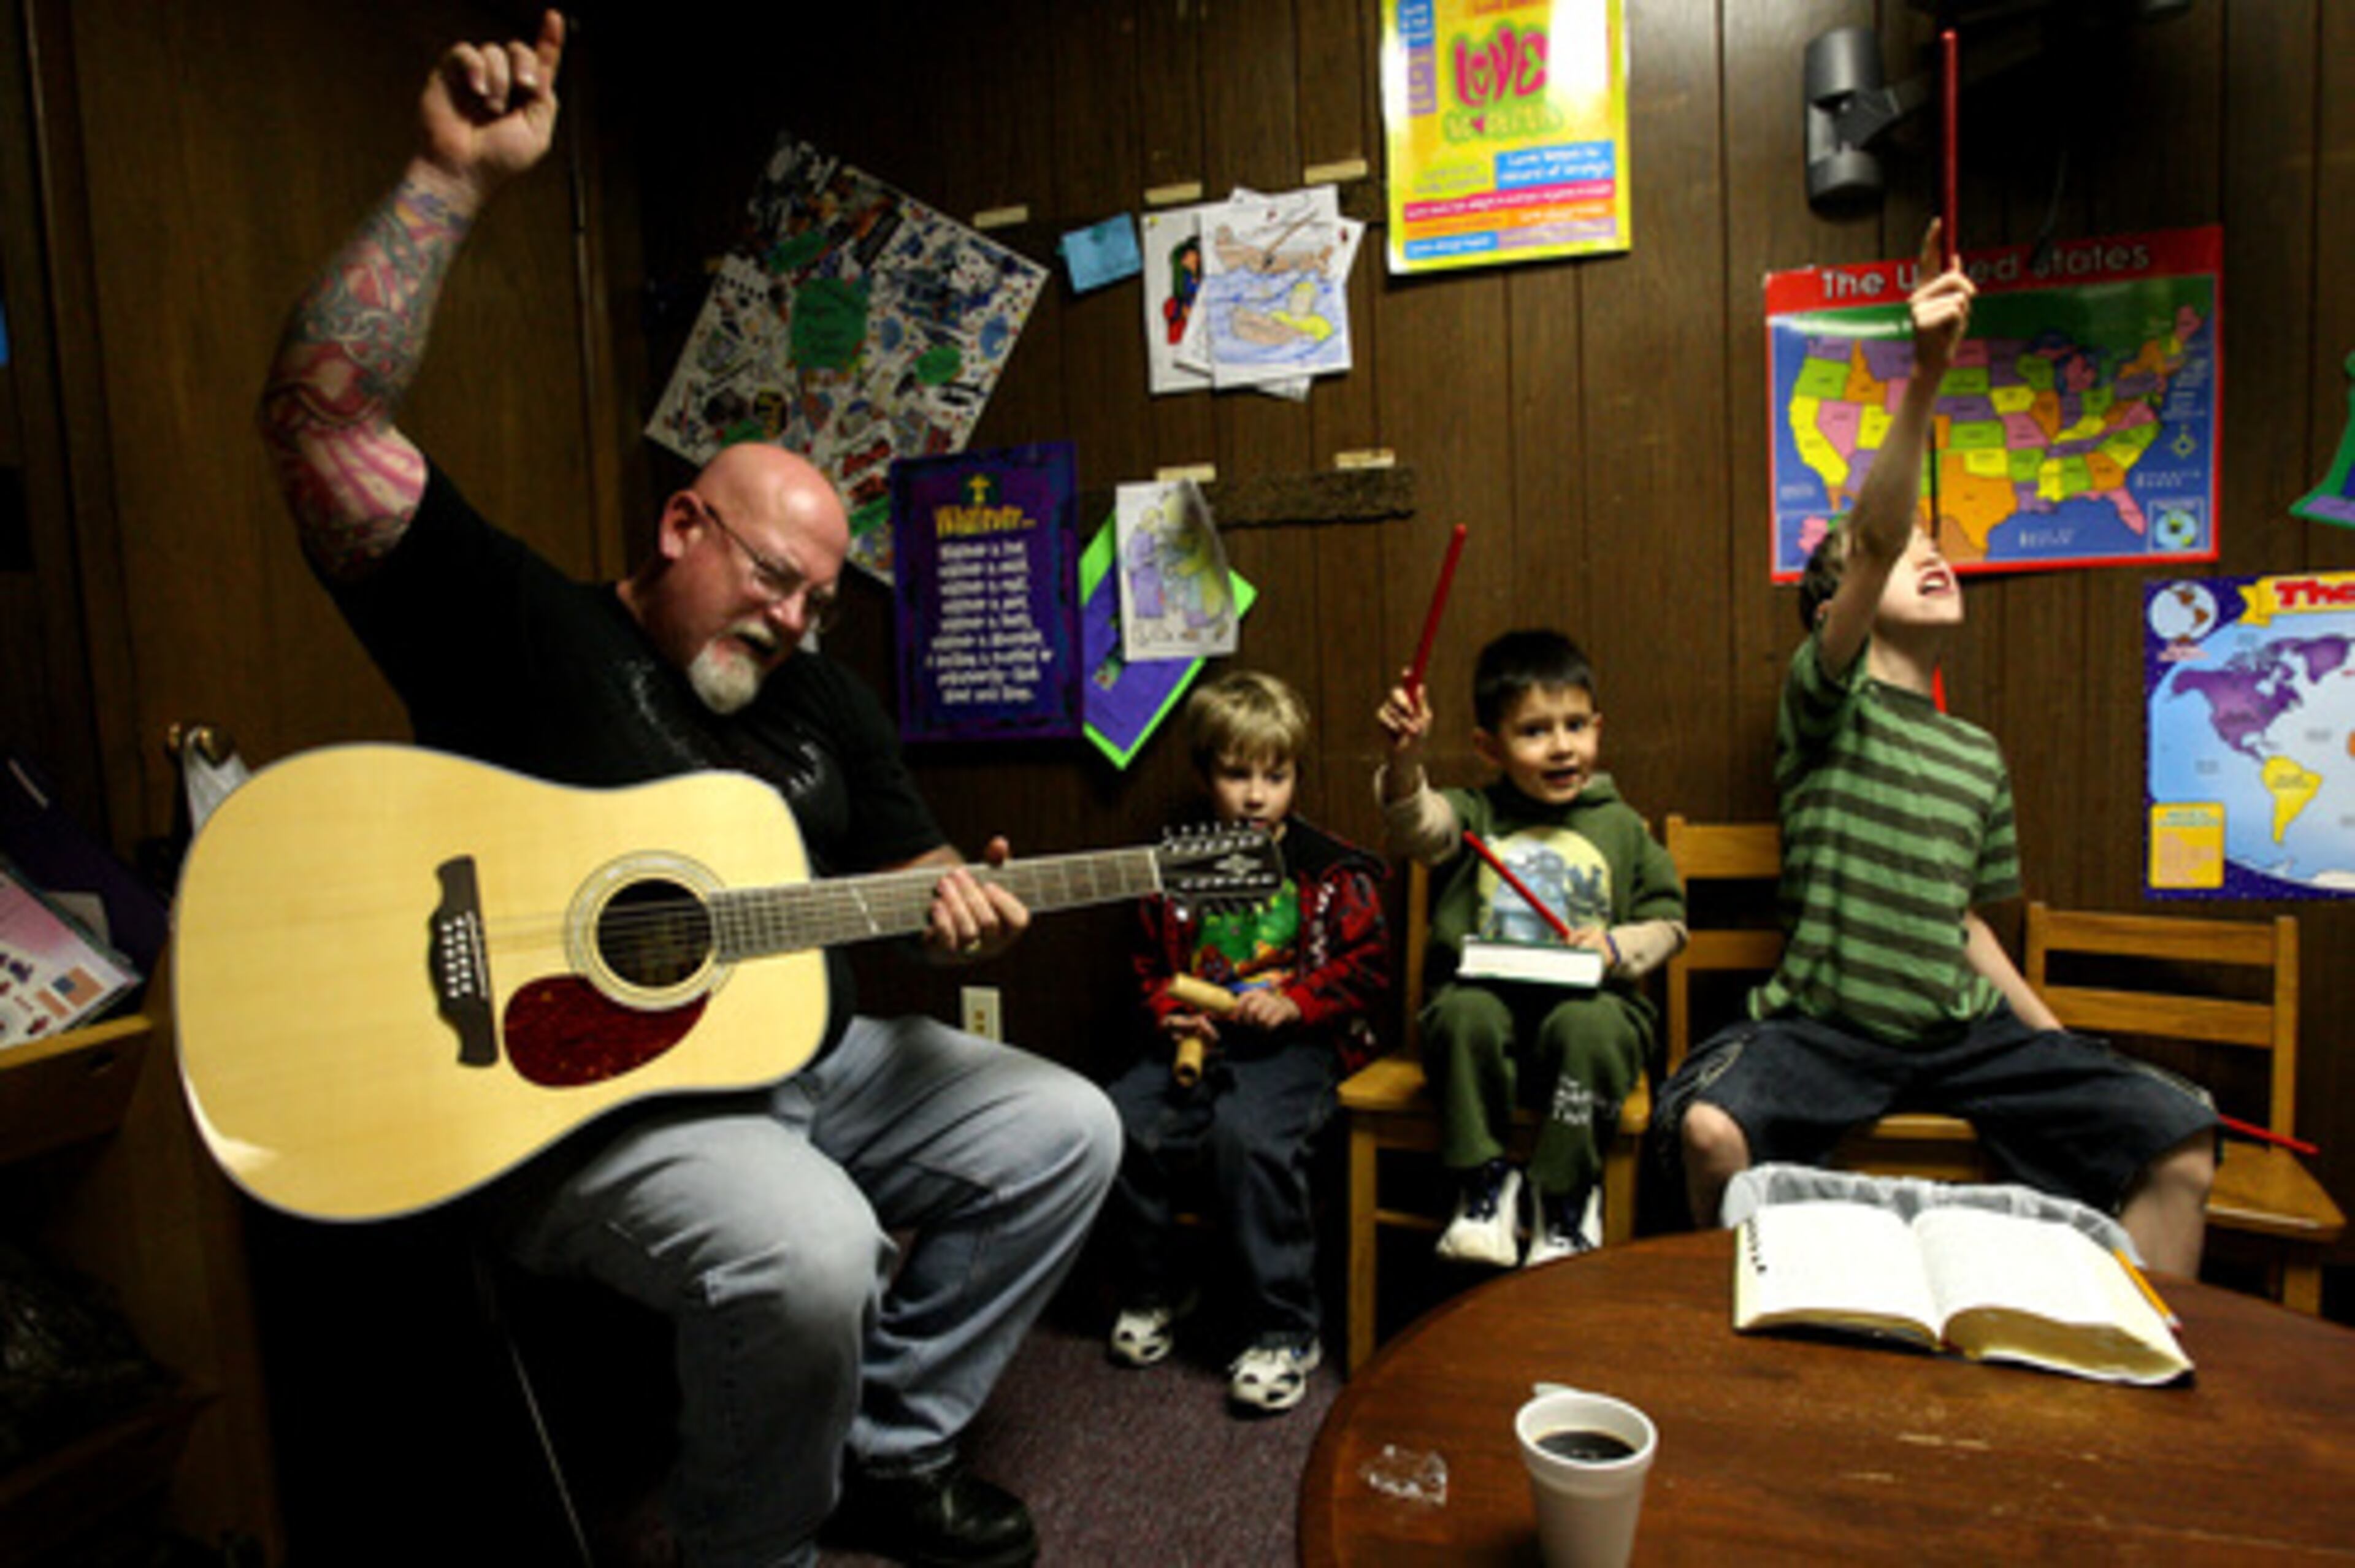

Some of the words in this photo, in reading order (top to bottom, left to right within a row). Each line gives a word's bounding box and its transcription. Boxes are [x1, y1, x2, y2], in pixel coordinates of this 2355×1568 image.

[1821, 267, 1884, 299] The
[1897, 252, 2021, 290] Ued
[2274, 578, 2355, 607] The
